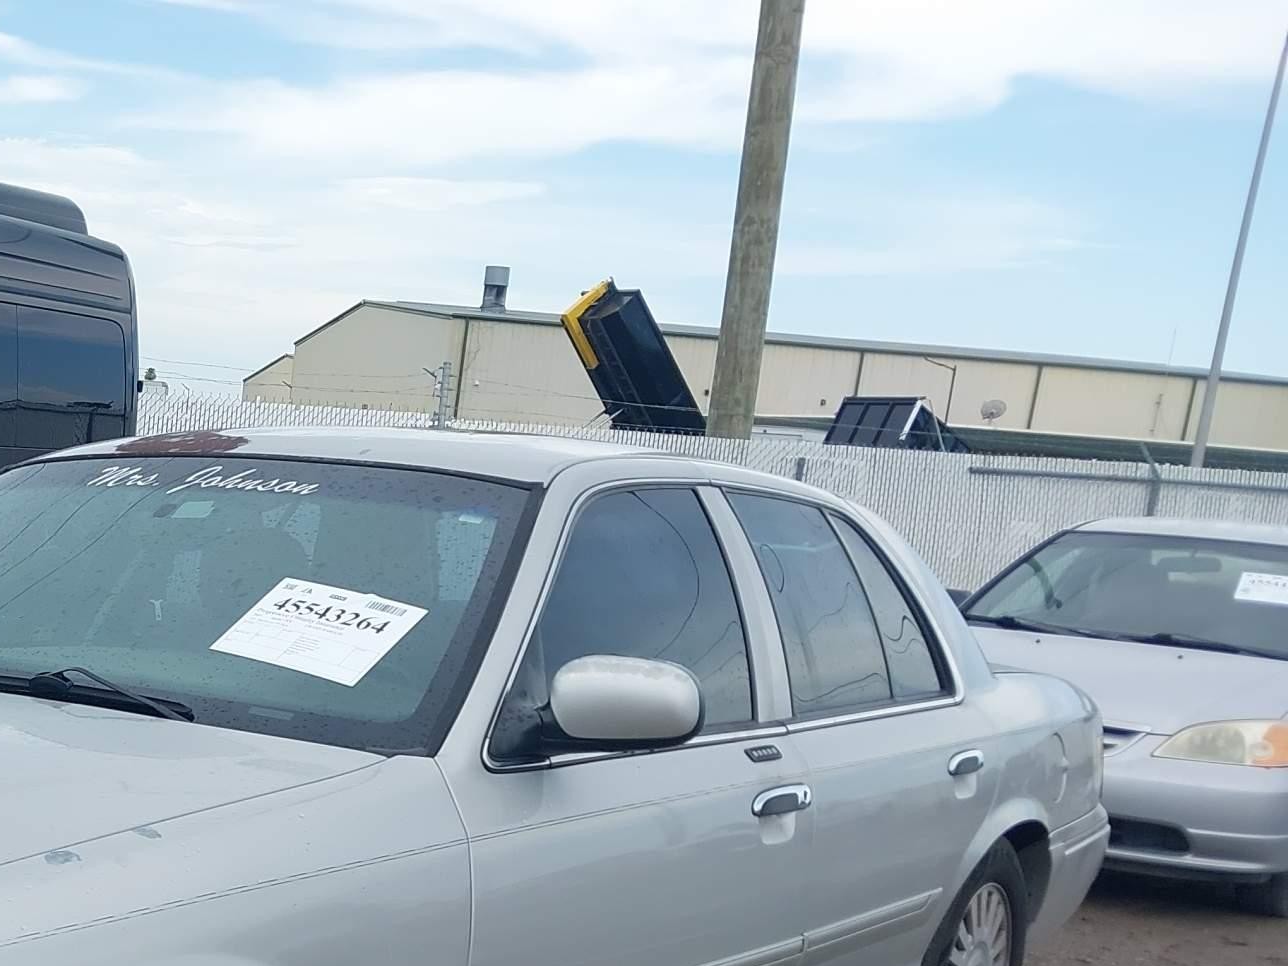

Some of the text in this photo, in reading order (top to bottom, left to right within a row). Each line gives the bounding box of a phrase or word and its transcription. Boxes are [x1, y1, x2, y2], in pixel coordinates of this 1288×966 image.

[87, 466, 320, 495] Mrs. Johnson
[273, 597, 391, 635] 45543264
